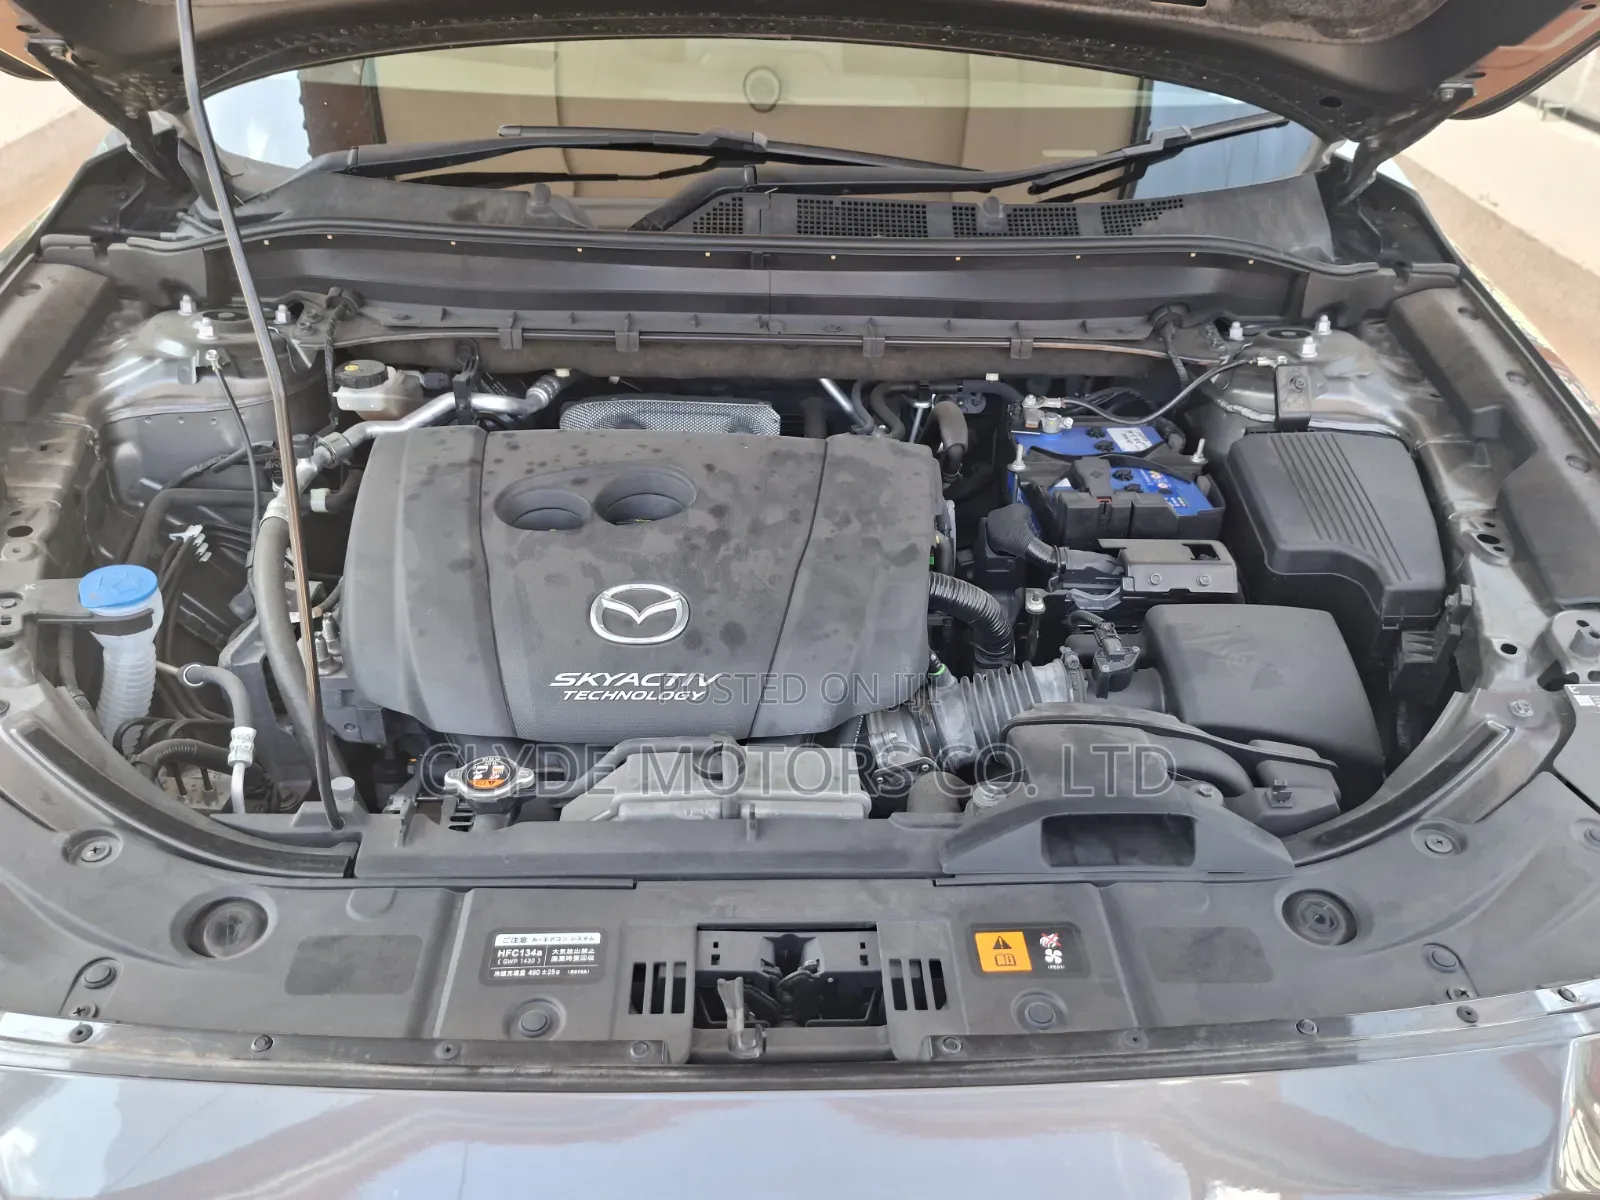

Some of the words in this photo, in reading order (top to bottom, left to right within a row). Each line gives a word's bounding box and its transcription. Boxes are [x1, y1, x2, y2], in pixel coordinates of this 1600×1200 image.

[549, 672, 723, 687] SKYACTIV
[563, 690, 706, 701] TECHNOLOGY
[498, 948, 542, 958] HFC134a
